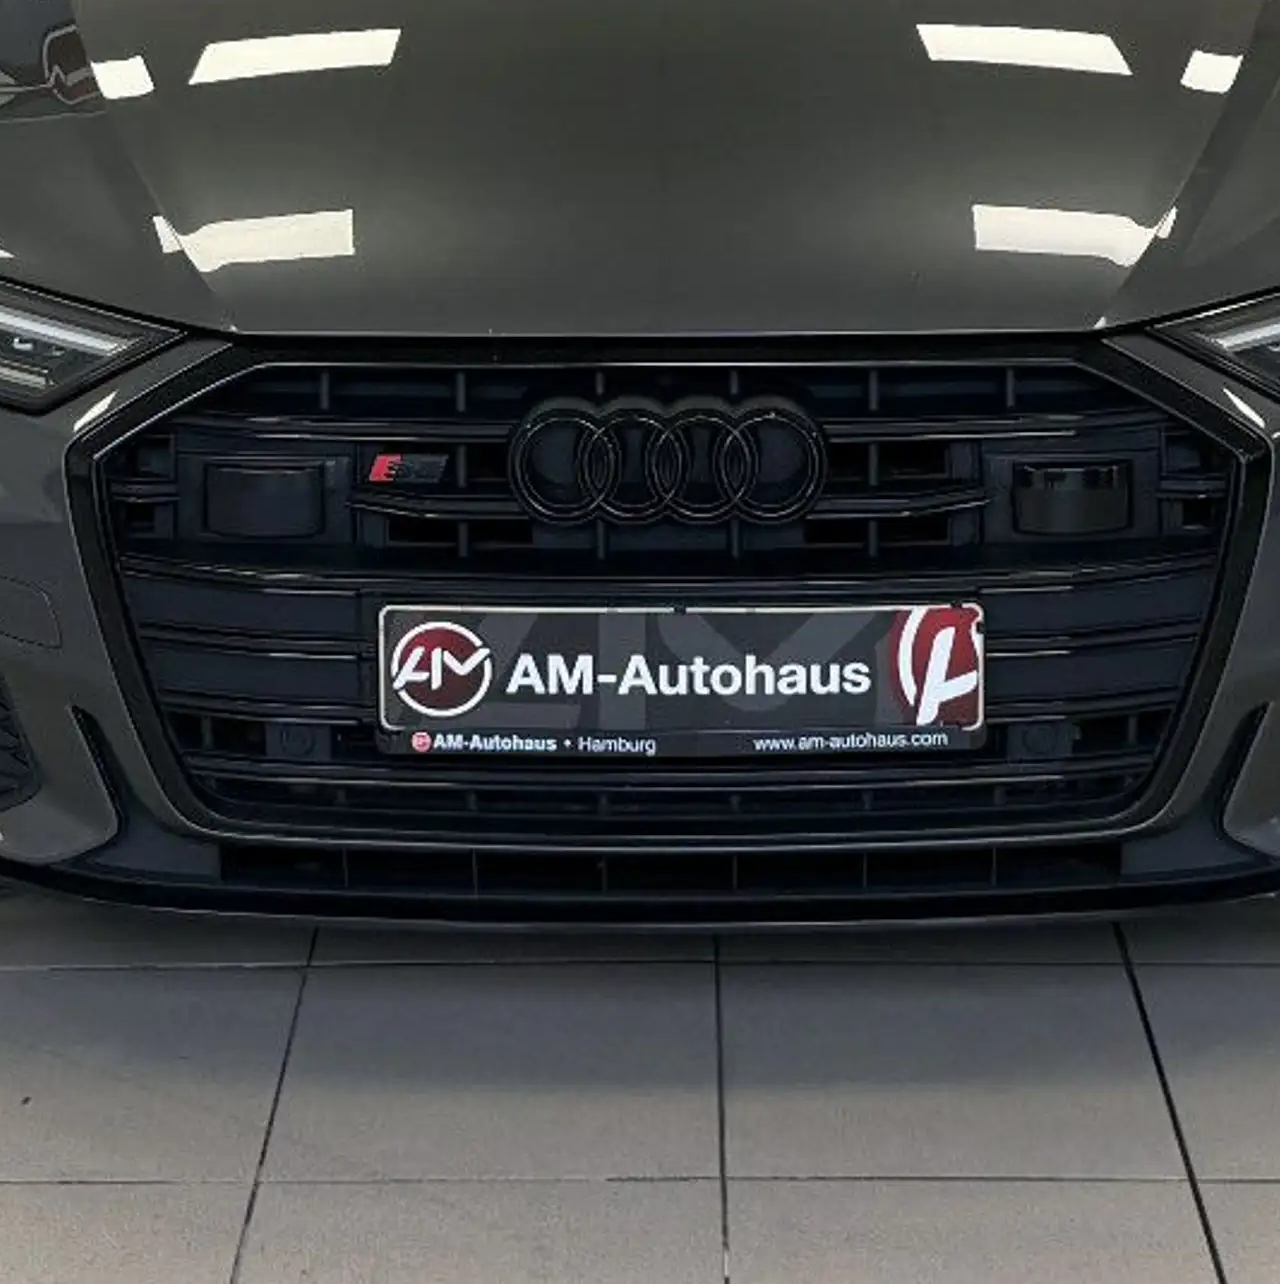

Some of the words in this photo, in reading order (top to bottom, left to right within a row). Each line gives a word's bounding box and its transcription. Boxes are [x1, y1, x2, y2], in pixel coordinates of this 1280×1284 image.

[504, 652, 872, 697] AM-Autohaus
[432, 732, 558, 752] AM-Autohaus
[577, 735, 658, 758] Hamburg
[751, 729, 950, 752] www.am-autohaus.com
